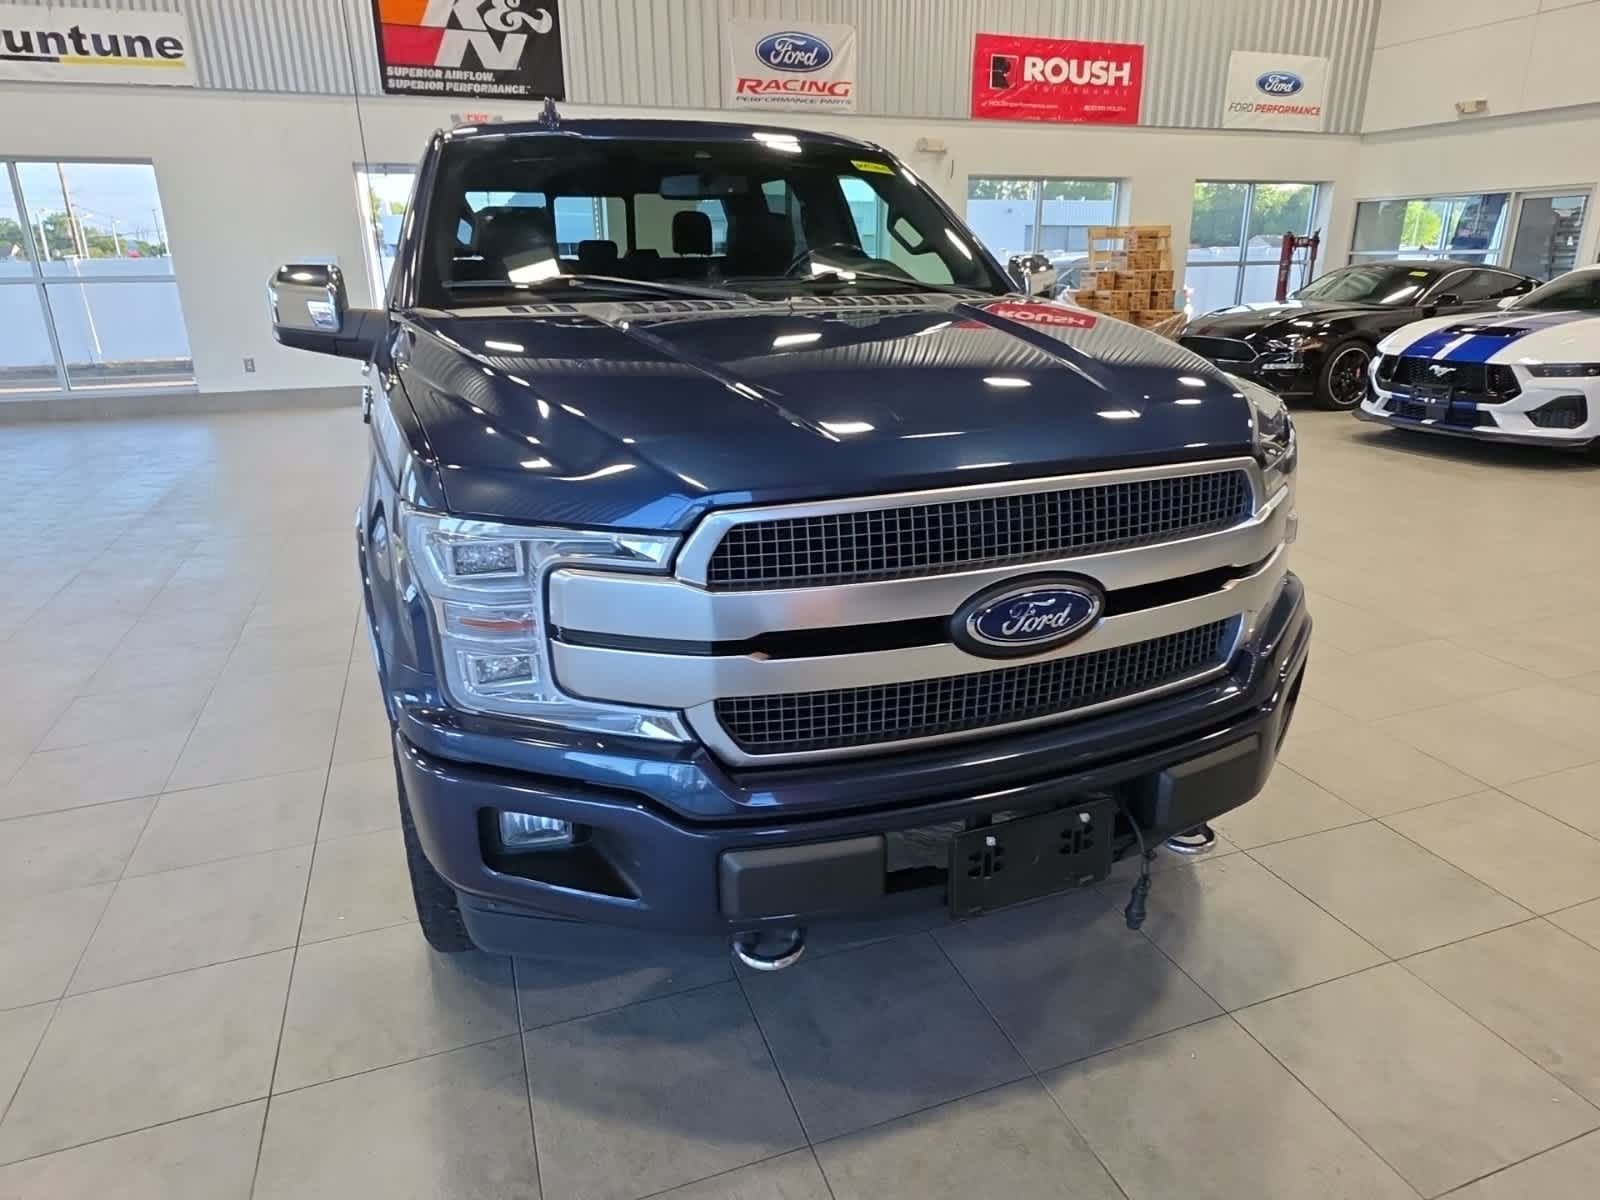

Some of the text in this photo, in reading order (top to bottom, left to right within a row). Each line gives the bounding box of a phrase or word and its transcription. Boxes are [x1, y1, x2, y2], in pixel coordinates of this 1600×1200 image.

[0, 25, 184, 59] untune
[770, 37, 818, 66] Ford
[386, 66, 496, 82] SUPERIOR AIRFLOW.
[1023, 56, 1131, 86] ROUSH
[388, 78, 445, 91] SUPERIOR
[736, 78, 852, 97] RACING
[1264, 74, 1295, 92] Ford
[1228, 102, 1321, 116] FORD PERFORMANCE
[1002, 598, 1073, 635] Ford
